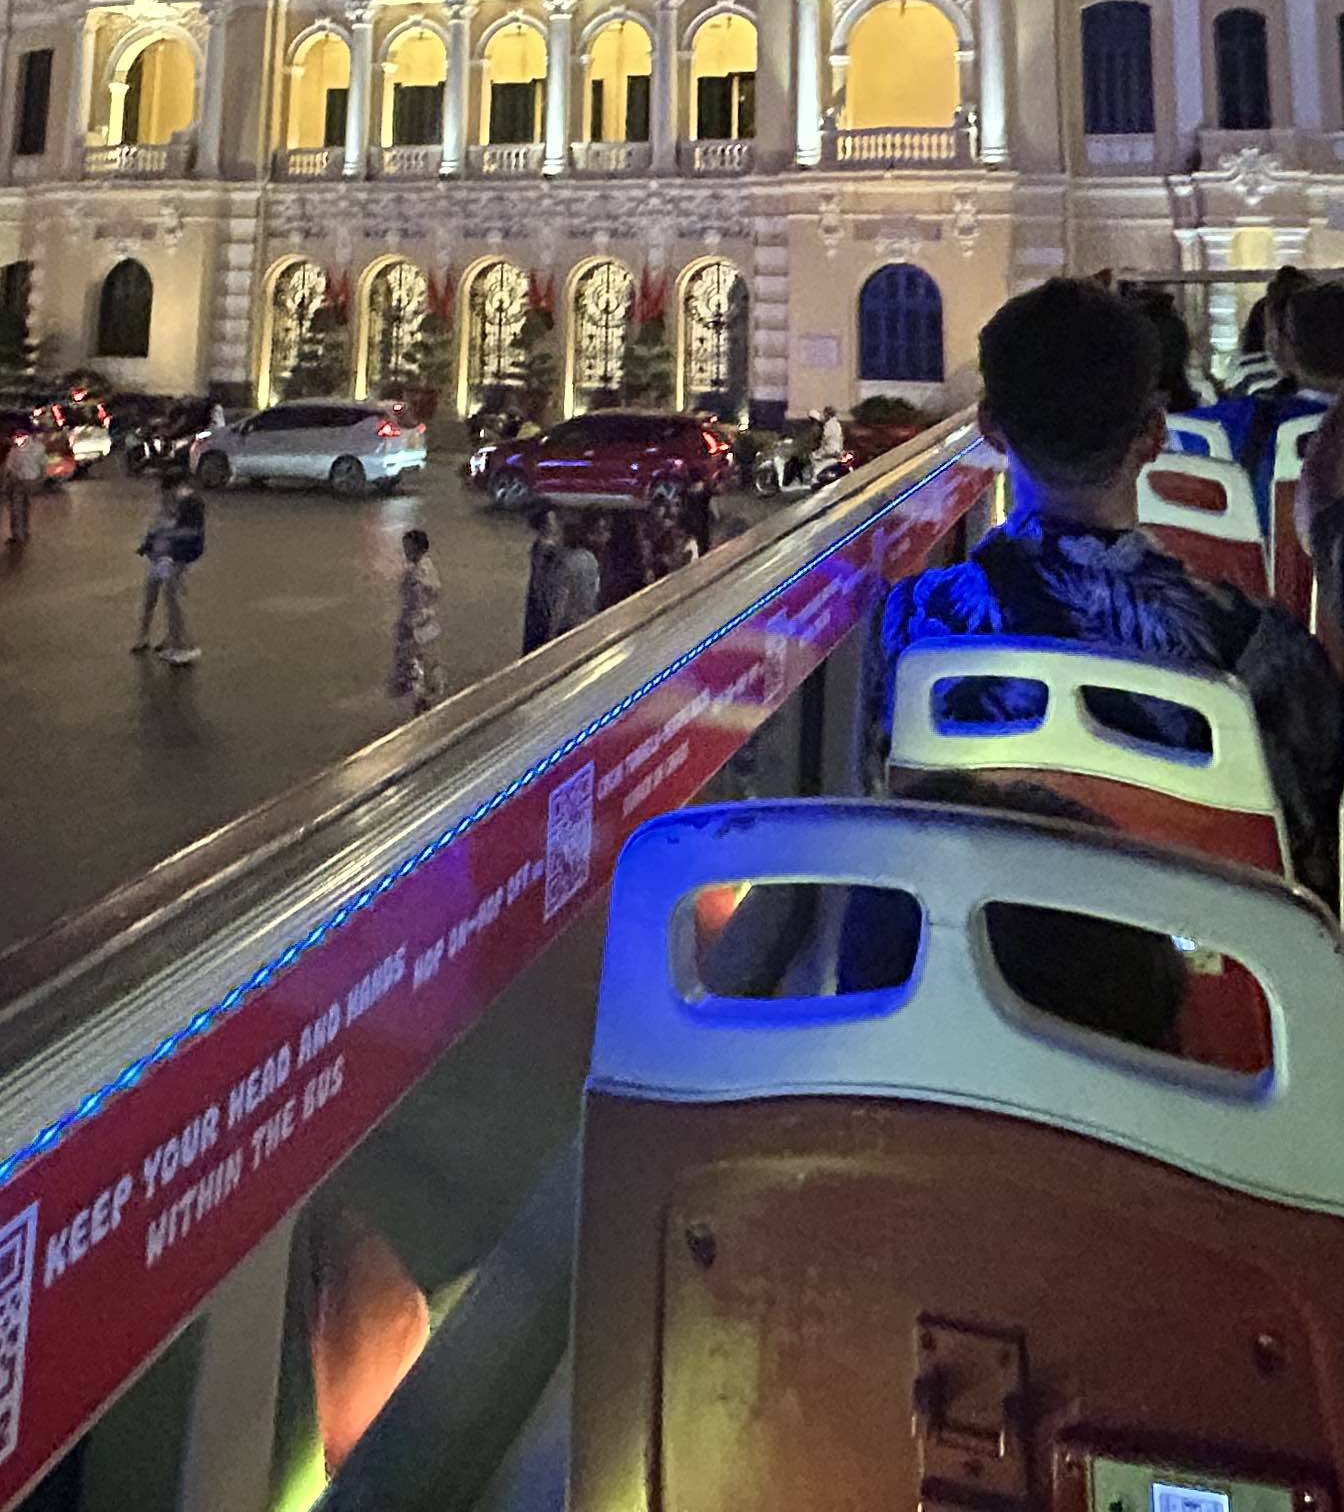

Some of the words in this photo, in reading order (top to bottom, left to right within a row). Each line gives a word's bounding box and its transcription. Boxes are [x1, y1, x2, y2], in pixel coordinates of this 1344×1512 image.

[43, 1173, 133, 1289] KEEP
[144, 1104, 221, 1201] YOUR
[227, 1041, 292, 1130] HEAD
[297, 1000, 341, 1070] AND
[346, 942, 406, 1028] HANDS
[147, 1148, 244, 1270] WITHIN
[251, 1098, 297, 1171] THE
[302, 1054, 346, 1121] BUS
